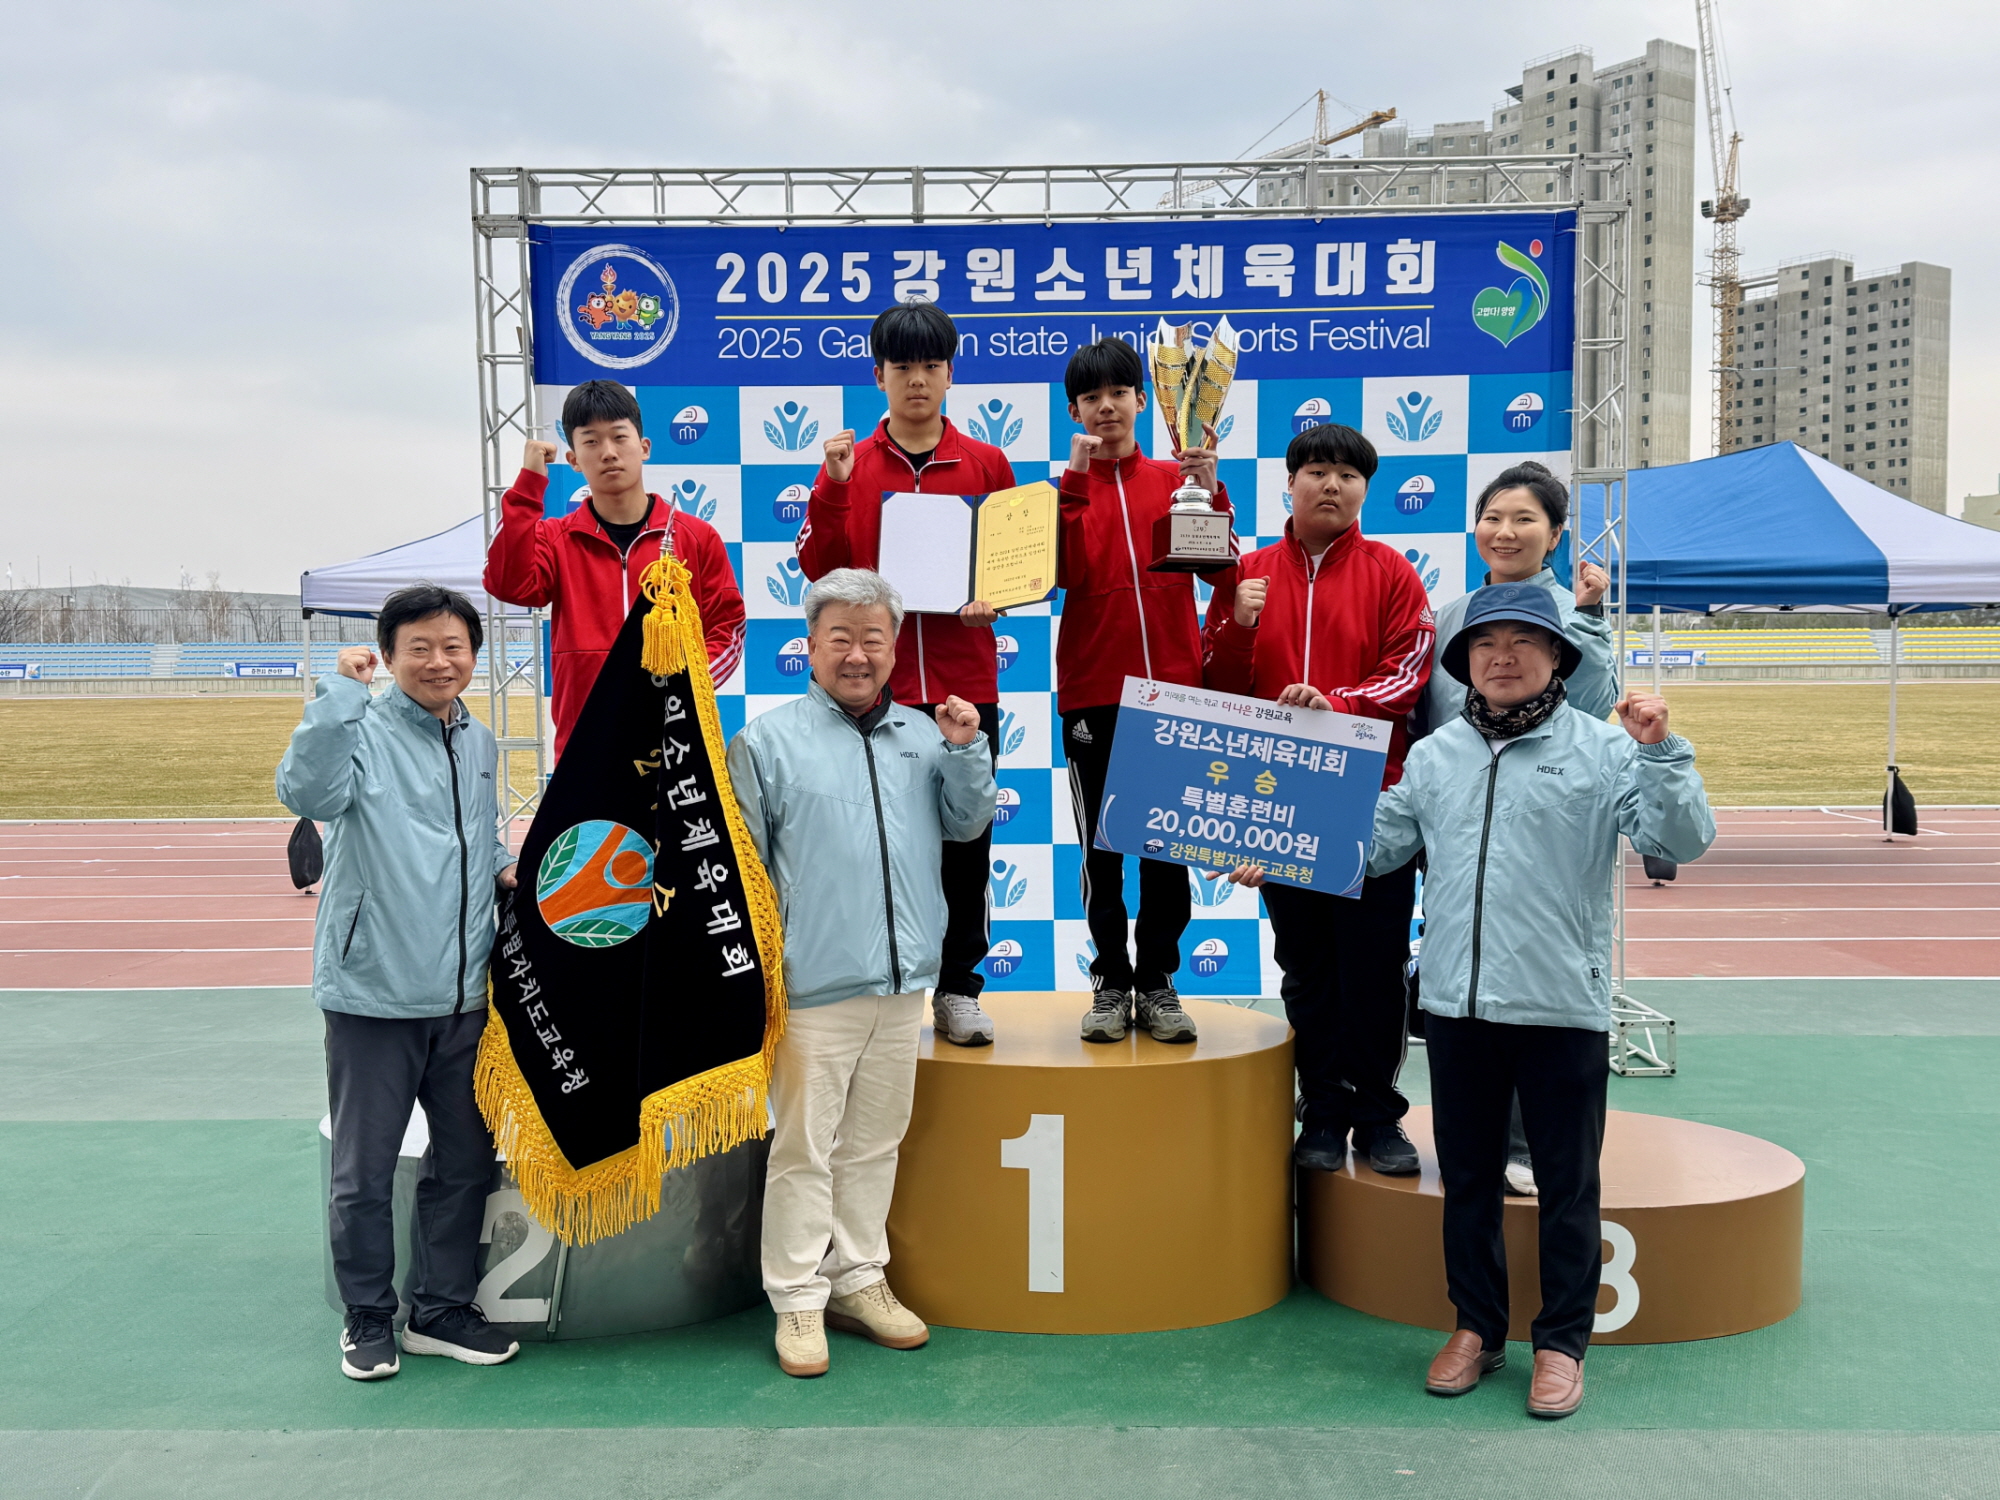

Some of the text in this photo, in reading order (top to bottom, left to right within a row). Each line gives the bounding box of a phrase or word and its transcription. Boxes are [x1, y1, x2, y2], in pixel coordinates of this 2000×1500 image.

[715, 251, 871, 304] 2025
[717, 327, 803, 360] 2025
[988, 325, 1068, 357] state
[1191, 319, 1297, 353] Sorts
[1310, 317, 1430, 352] Festival
[1255, 706, 1294, 724] 강원교육
[1153, 718, 1348, 777] 강원소년체육대회
[1536, 764, 1565, 776] HDEX
[1180, 786, 1296, 828] 특별훈련비
[1146, 807, 1320, 861] 20,000,000원
[1001, 1114, 1064, 1292] 1
[474, 1189, 561, 1323] 2
